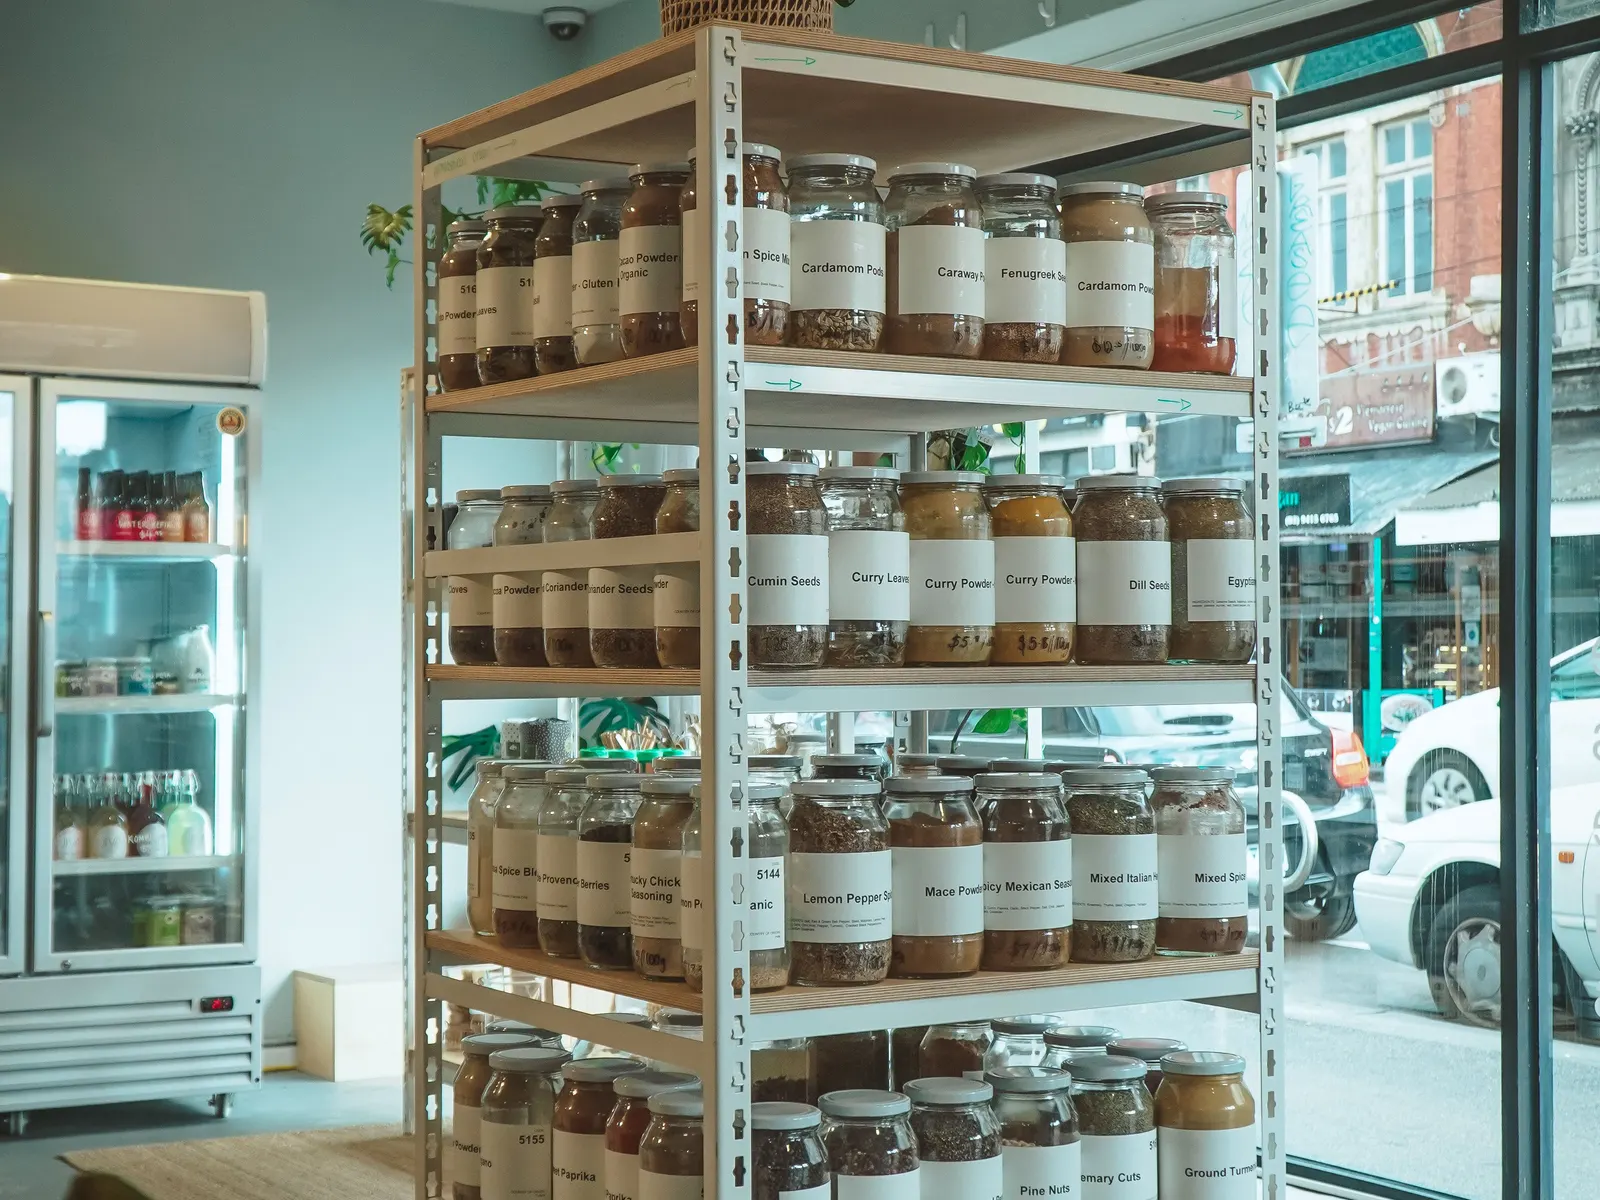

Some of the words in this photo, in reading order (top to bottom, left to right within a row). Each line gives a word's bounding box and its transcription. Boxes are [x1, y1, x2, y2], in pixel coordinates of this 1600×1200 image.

[636, 253, 678, 263] Powder
[753, 249, 780, 262] Spice
[801, 262, 864, 274] Cardamom
[866, 264, 884, 277] Pods
[937, 266, 979, 283] Caraway
[1001, 268, 1056, 281] Fenugreek
[460, 284, 476, 294] 516
[582, 278, 613, 289] Gluten
[1077, 280, 1137, 292] Cardamom
[445, 310, 476, 319] Powder
[748, 575, 787, 587] Cumin
[791, 575, 821, 587] Seeds
[852, 571, 884, 585] Curry
[1006, 574, 1038, 587] Curry
[545, 582, 588, 592] Coriander
[618, 583, 654, 594] Seeds
[925, 578, 958, 590] Curry
[1129, 580, 1147, 590] Dill
[1149, 580, 1170, 591] Seeds
[503, 585, 540, 595] Powder
[498, 865, 520, 876] Spice
[757, 868, 780, 880] 5144
[1090, 872, 1124, 884] Mixed
[1126, 872, 1152, 883] Italian
[1194, 872, 1227, 883] Mixed
[581, 879, 609, 891] Berries
[1005, 881, 1052, 892] Mexican
[925, 886, 955, 897] Mace
[803, 893, 843, 904] Lemon
[847, 893, 882, 906] Pepper
[519, 1134, 545, 1145] 5155
[561, 1168, 596, 1182] Paprika
[1118, 1172, 1141, 1183] Cuts
[1185, 1167, 1227, 1178] Ground
[1020, 1186, 1046, 1196] Pine
[1048, 1184, 1070, 1195] Nuts
